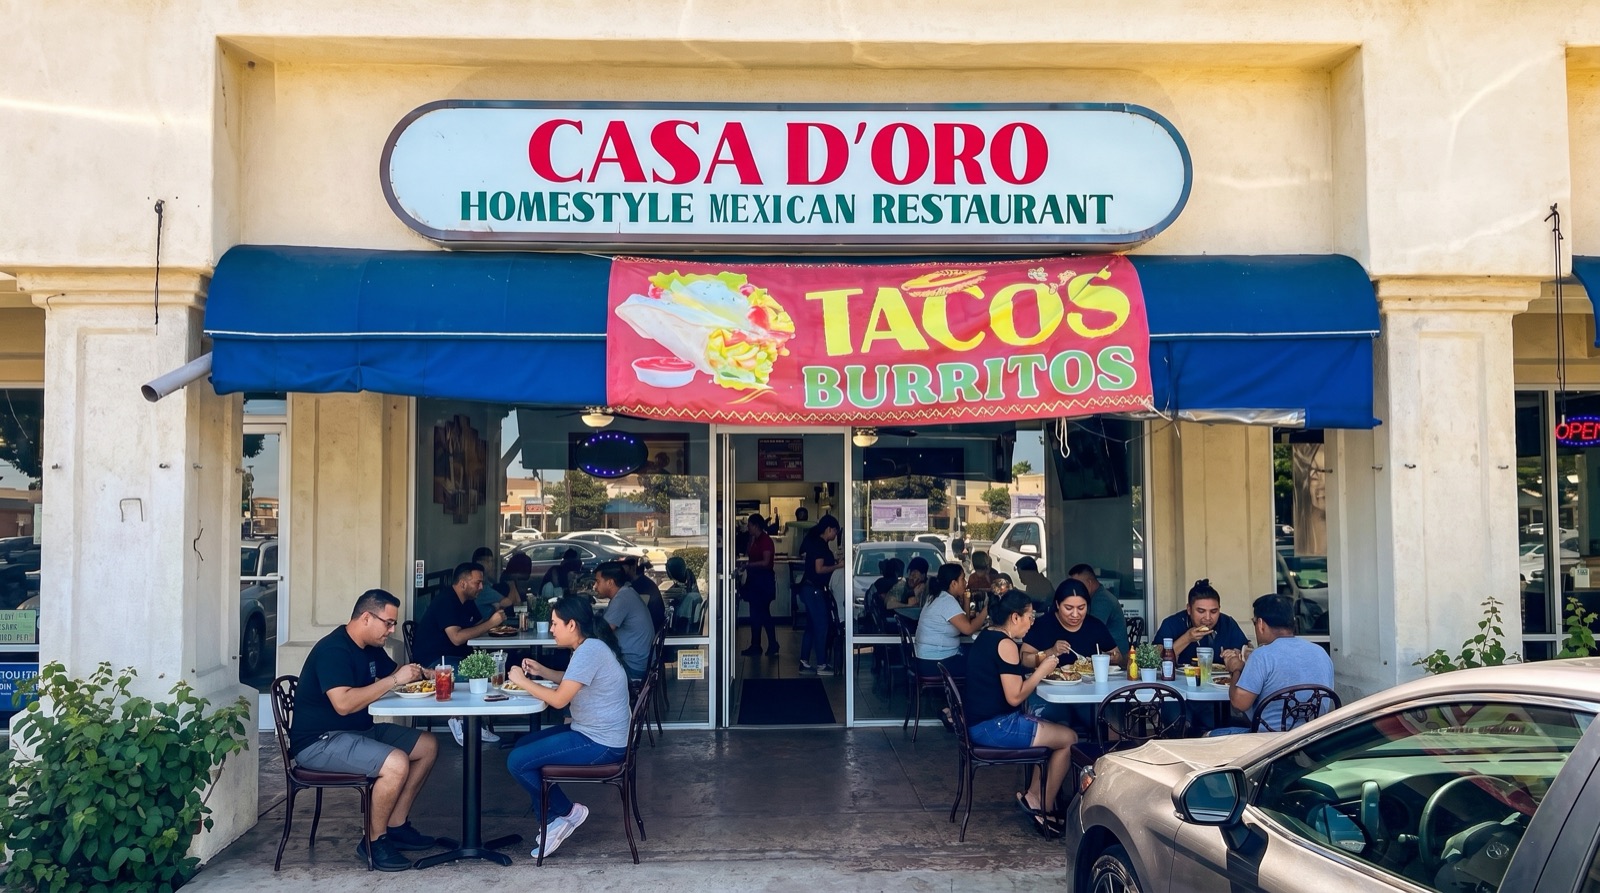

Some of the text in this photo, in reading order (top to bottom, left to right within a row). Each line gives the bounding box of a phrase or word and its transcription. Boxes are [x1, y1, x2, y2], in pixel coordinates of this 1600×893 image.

[528, 119, 1049, 185] CASA D'ORO
[460, 190, 1114, 224] HOMESTYLE MEXICAN RESTAURANT
[805, 268, 1131, 356] TACOS
[802, 345, 1137, 409] BURRITOS
